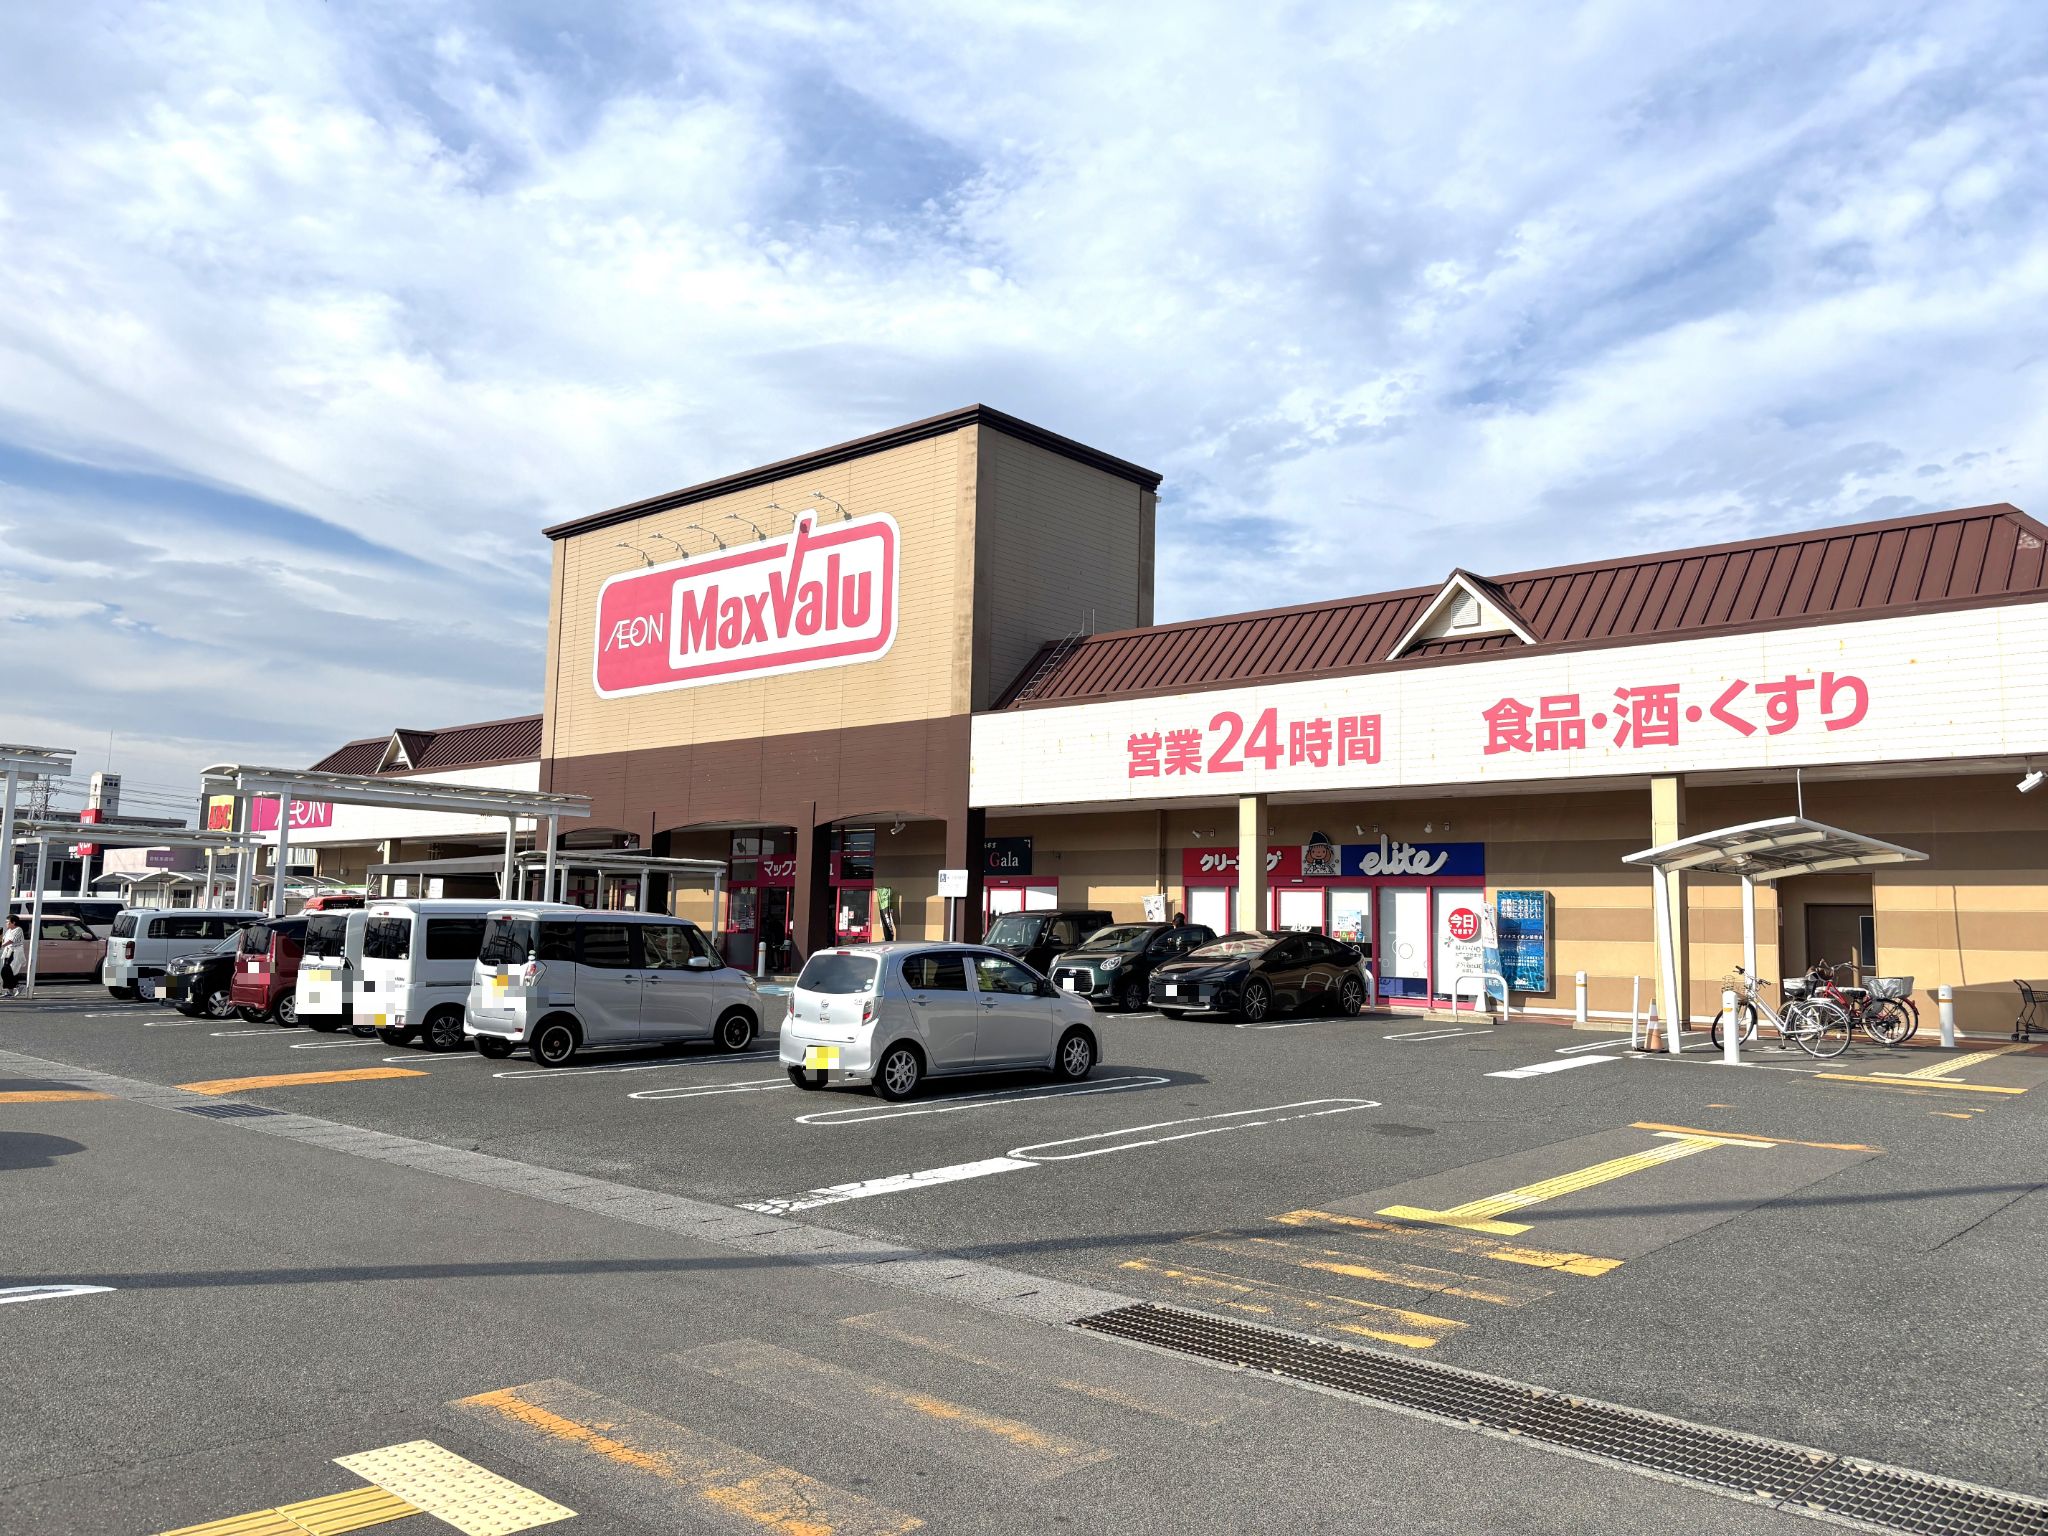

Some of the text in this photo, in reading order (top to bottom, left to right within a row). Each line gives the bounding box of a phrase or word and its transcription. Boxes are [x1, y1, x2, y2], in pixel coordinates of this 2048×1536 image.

[679, 517, 872, 656] MaxValu
[1127, 707, 1382, 778] 営業24時間
[989, 851, 1019, 867] Gala
[1200, 851, 1283, 872] クリーグ
[1358, 833, 1448, 876] elite
[1450, 913, 1474, 929] 今日
